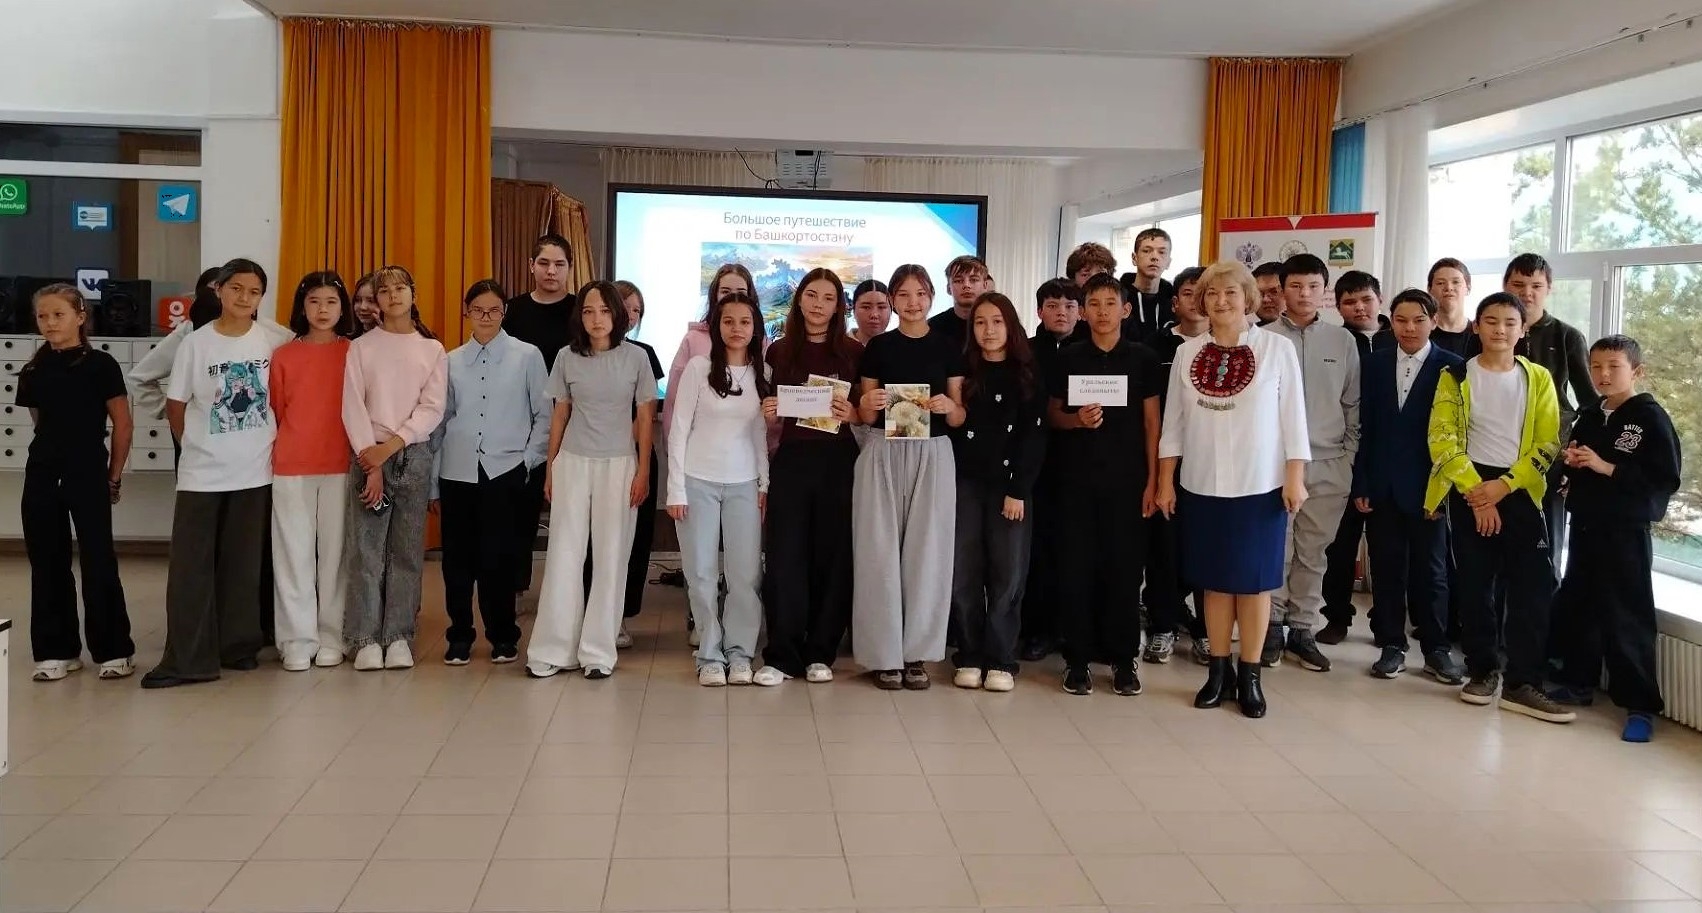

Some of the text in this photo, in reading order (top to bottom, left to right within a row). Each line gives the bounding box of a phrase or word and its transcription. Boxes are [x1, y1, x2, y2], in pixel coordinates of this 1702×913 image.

[723, 211, 867, 229] Большое путешествие
[735, 228, 854, 245] по Башкортостану
[1615, 431, 1642, 449] 23
